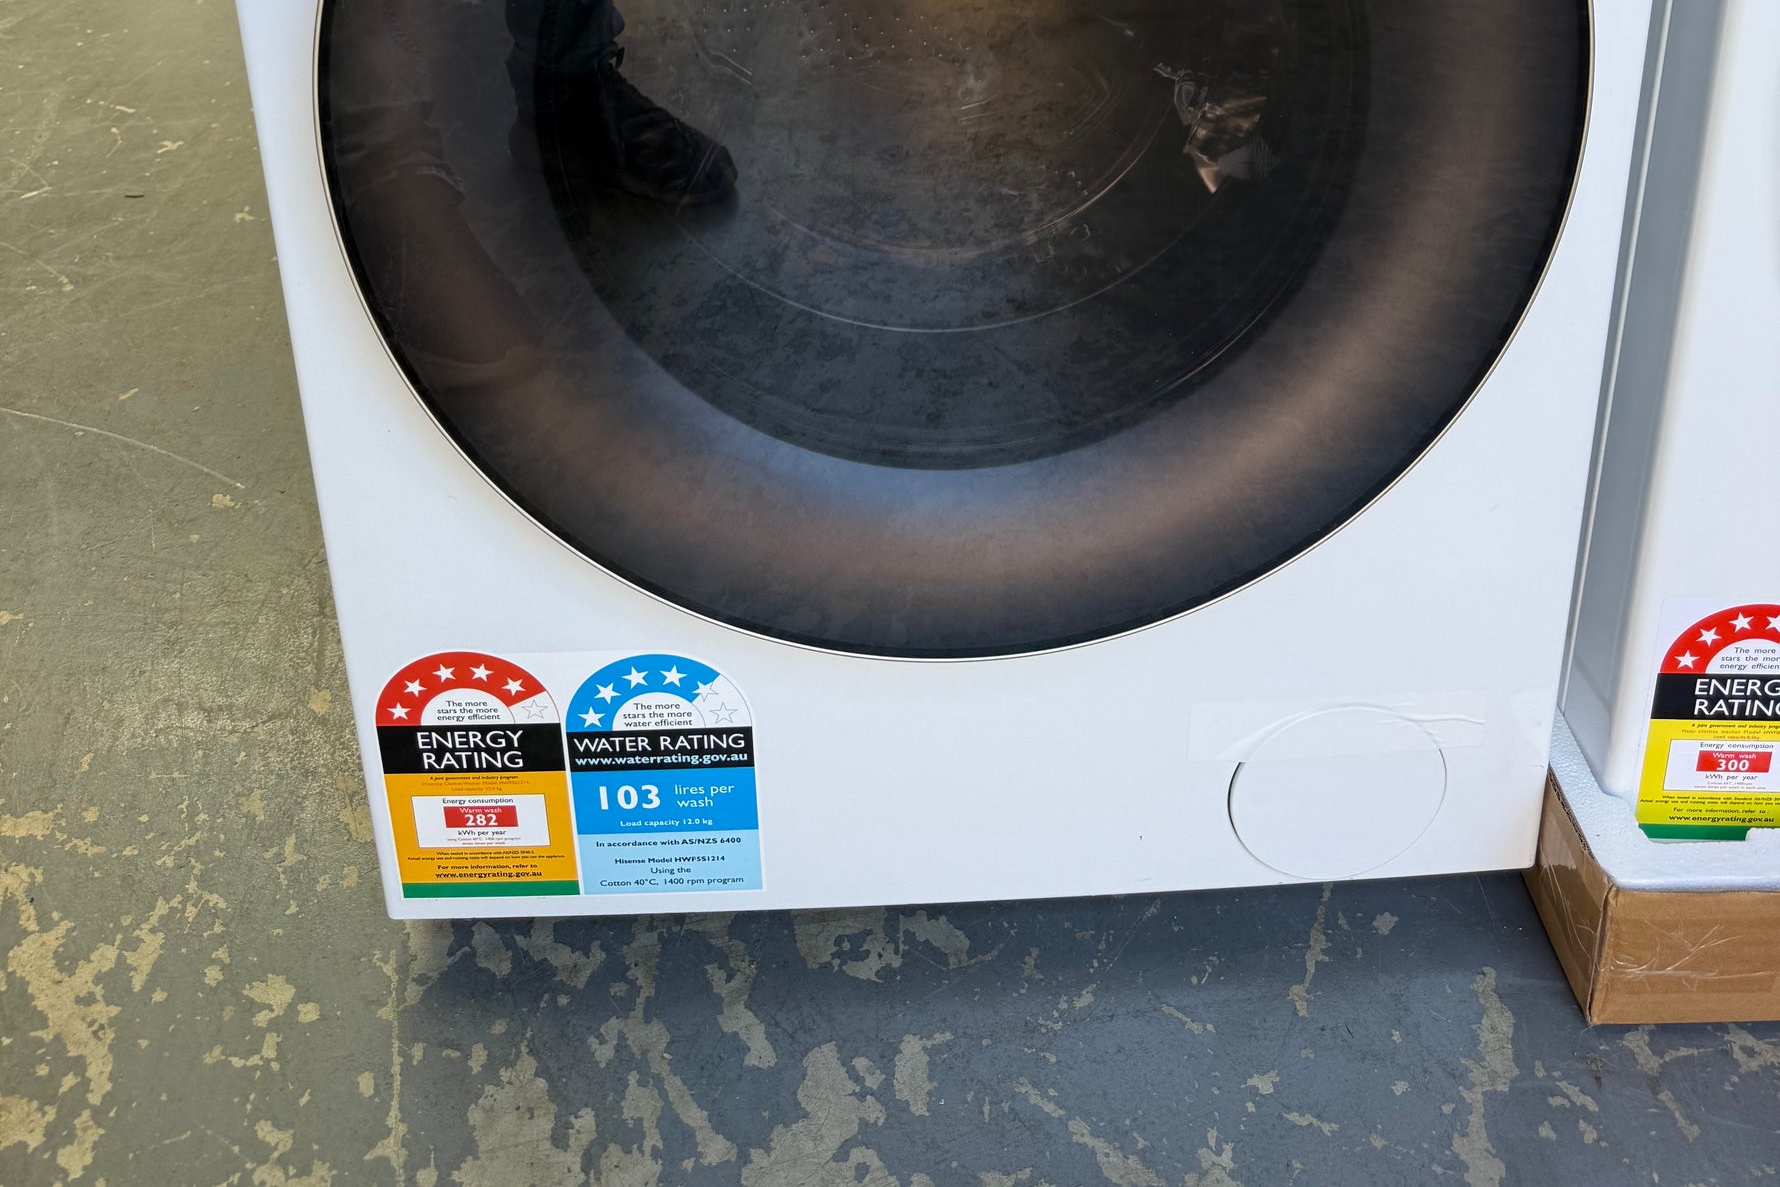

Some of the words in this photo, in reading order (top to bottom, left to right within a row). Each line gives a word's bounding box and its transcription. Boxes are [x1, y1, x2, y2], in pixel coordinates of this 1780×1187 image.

[437, 714, 465, 722] energy
[416, 730, 523, 749] ENERGY
[573, 737, 652, 753] WATER
[659, 734, 745, 750] RATING
[1728, 742, 1774, 750] consumption
[422, 751, 524, 769] RATING
[575, 753, 748, 765] www.waterrating.gov.au
[1716, 759, 1749, 771] 300
[599, 784, 661, 810] 103
[674, 784, 705, 795] lires
[710, 784, 735, 797] per
[677, 796, 714, 808] wash
[464, 814, 498, 826] 282
[644, 819, 680, 828] capacity
[702, 818, 713, 826] kg
[1669, 815, 1775, 823] www.energyrating.gov.au
[681, 837, 718, 845] AS/NZS
[648, 856, 673, 864] Model
[435, 870, 542, 879] www.energyrating.gov.au
[650, 867, 675, 875] Using
[600, 879, 631, 887] Cotton
[687, 878, 705, 886] rpm
[707, 876, 744, 885] program
